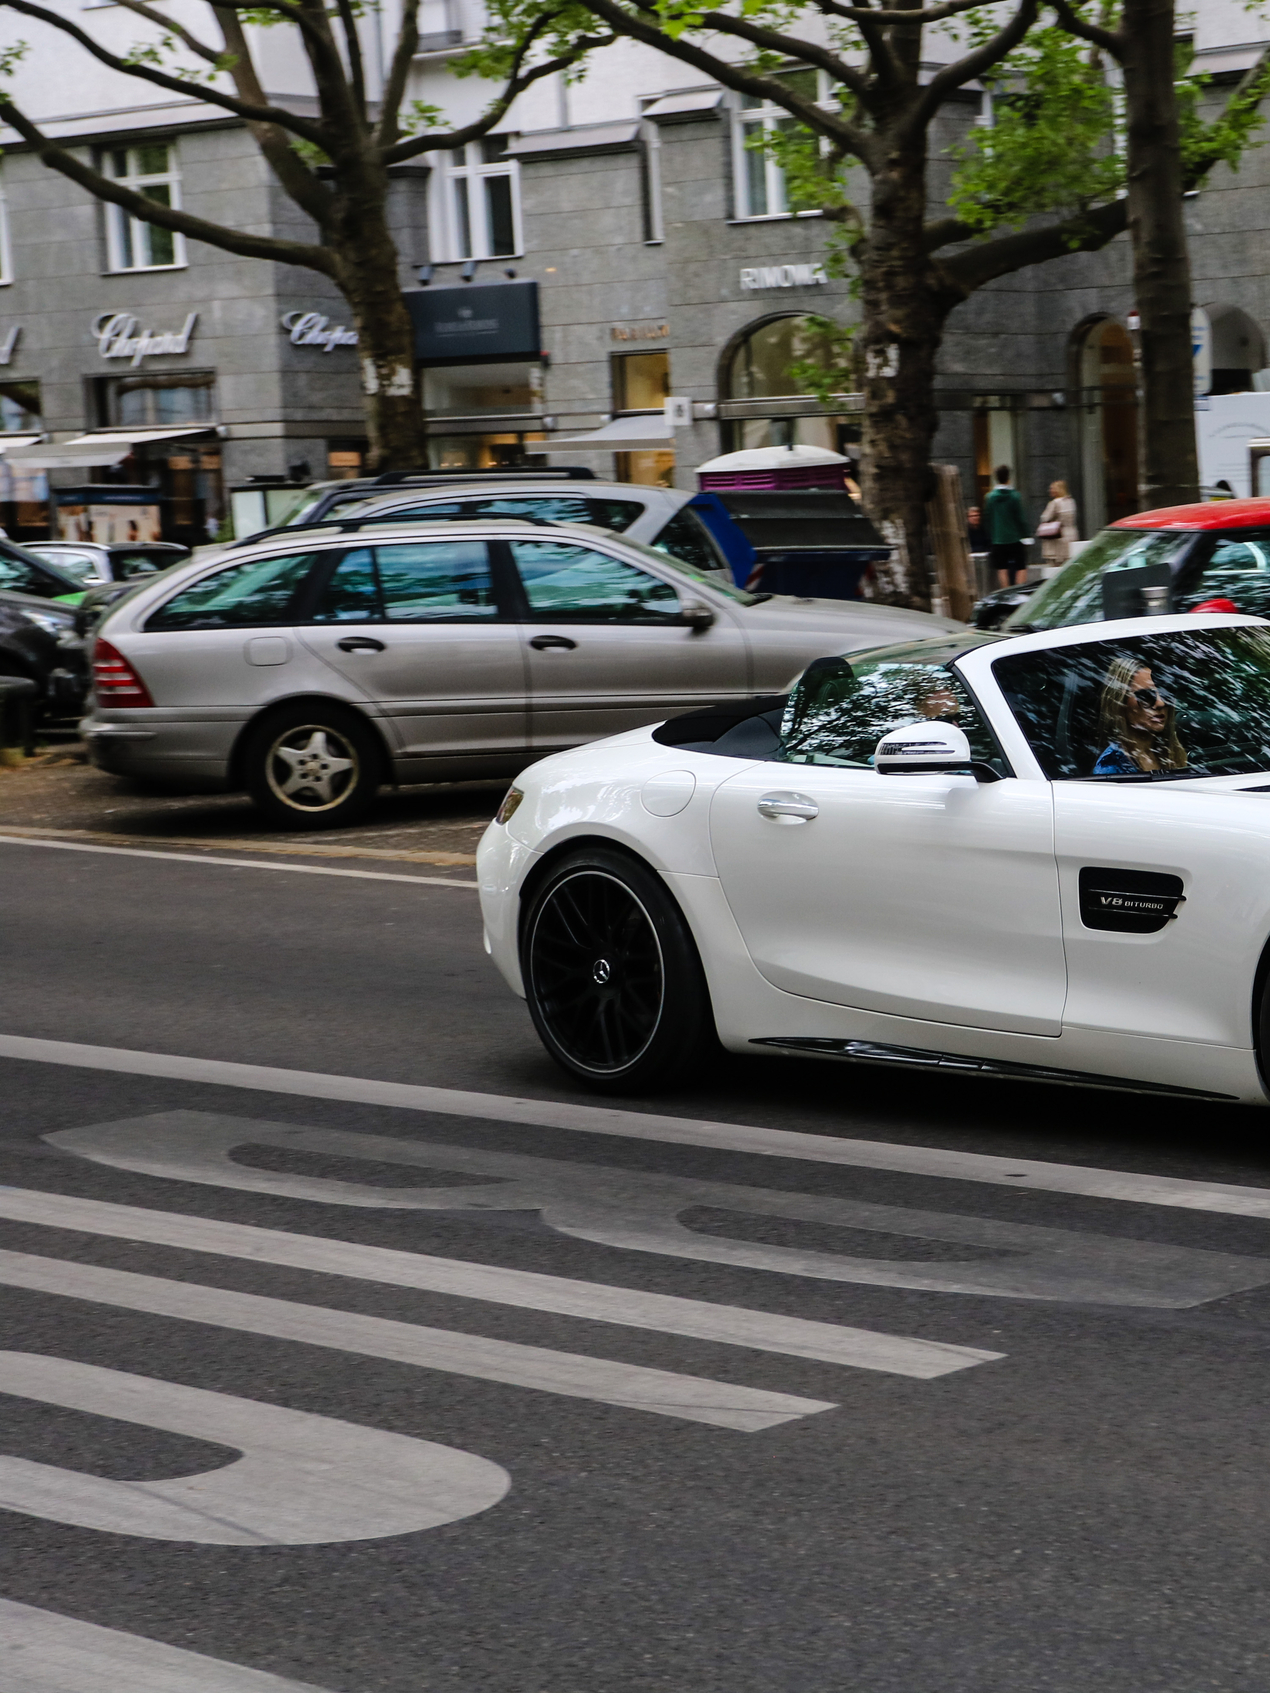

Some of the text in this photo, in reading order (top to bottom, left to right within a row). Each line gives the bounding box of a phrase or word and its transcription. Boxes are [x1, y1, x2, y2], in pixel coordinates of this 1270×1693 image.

[740, 263, 828, 290] RIMOWA
[91, 313, 199, 366] Chopard
[282, 311, 359, 352] Chopa
[1100, 896, 1164, 910] V8 BITURBO
